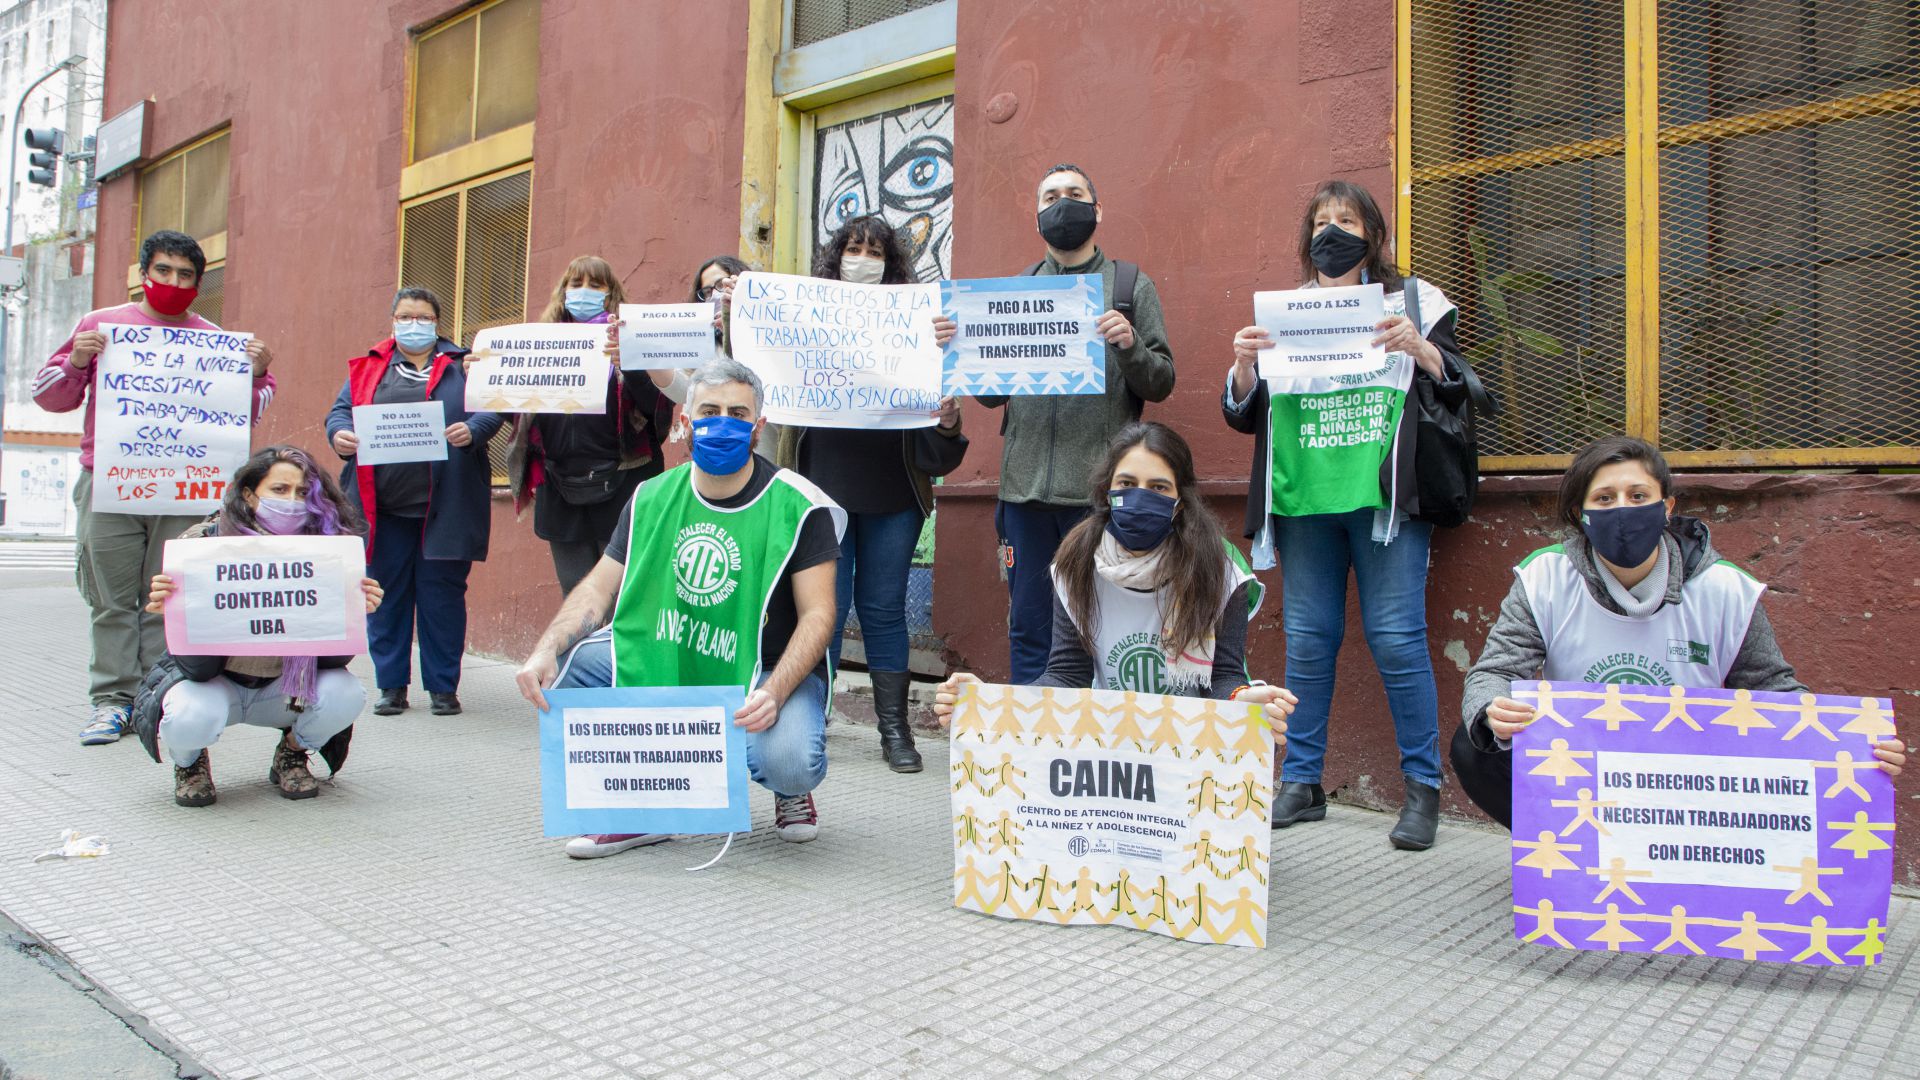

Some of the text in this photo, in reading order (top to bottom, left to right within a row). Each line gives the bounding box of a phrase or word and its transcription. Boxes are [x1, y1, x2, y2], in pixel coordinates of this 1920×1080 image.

[748, 278, 931, 310] LXS DERECHOS DE LA
[738, 302, 804, 323] NIÑEZ
[988, 300, 1054, 314] PAGO A LXS
[1288, 299, 1360, 310] PAGO A LXS
[112, 326, 151, 344] LOS
[966, 321, 1079, 337] MONOTRIBUTISTAS
[1280, 326, 1374, 336] MONOTRIBUTISTAS
[490, 340, 594, 350] NO A LOS DESCUENTOS
[751, 327, 918, 349] TRABAJADORXS CON
[979, 344, 1066, 358] TRANSFERIDXS
[1288, 352, 1364, 362] TRANSFRIDXS
[133, 351, 251, 374] DE LA NIÑEZ
[500, 356, 581, 368] POR LICENCIA
[794, 350, 876, 370] DERECHOS
[488, 374, 586, 386] DE AISLAMIENTO
[1364, 372, 1376, 382] LA
[846, 387, 858, 409] Y
[858, 387, 886, 410] SIN
[890, 387, 940, 410] COBRAR
[1300, 394, 1360, 410] CONSEJO
[1365, 392, 1384, 404] DE
[117, 397, 248, 427] TRABAJADORXS
[136, 426, 182, 441] CON
[376, 422, 430, 430] DESCUENTOS
[1301, 423, 1316, 436] DE
[1320, 418, 1364, 436] NIÑAS,
[383, 440, 439, 449] AISLAMIENTO
[394, 432, 433, 440] LICENCIA
[1299, 437, 1305, 449] Y
[119, 442, 208, 459] DERECHOS
[107, 465, 220, 481] AUMENTO PARA
[117, 481, 232, 500] LOS INT
[716, 528, 728, 541] EL
[724, 536, 741, 571] ESTADO
[216, 562, 314, 581] PAGO A LOS
[679, 541, 724, 588] ATE
[214, 590, 318, 610] CONTRATOS
[700, 596, 710, 607] LA
[250, 619, 285, 635] UBA
[656, 608, 666, 640] LA
[688, 618, 700, 648] Y
[696, 621, 738, 664] BLANCA
[1106, 632, 1148, 668] FORTALECER
[1669, 646, 1688, 656] VERDE
[1124, 652, 1167, 694] ATE
[1584, 653, 1634, 682] ORTALECER
[1637, 655, 1649, 669] EL
[1650, 662, 1675, 686] ESTA
[1107, 676, 1120, 690] PAR
[570, 720, 720, 736] LOS DERECHOS DE LA NIÑEZ
[569, 750, 723, 764] NECESITAN TRABAJADORXS
[604, 778, 690, 791] CON DERECHOS
[1050, 758, 1156, 803] CAINA
[1604, 772, 1808, 796] LOS DERECHOS DE LA NIÑEZ
[1016, 806, 1060, 816] (CENTRO
[1081, 809, 1134, 820] ATENCIÓN
[1136, 814, 1186, 828] INTEGRAL
[1603, 806, 1812, 832] NECESITAN TRABAJADORXS
[1036, 820, 1048, 828] LA
[1052, 820, 1083, 830] NIÑEZ
[1096, 822, 1177, 841] ADOLESCENCIA)
[1070, 838, 1087, 855] ATE
[1648, 844, 1765, 865] CON DERECHOS
